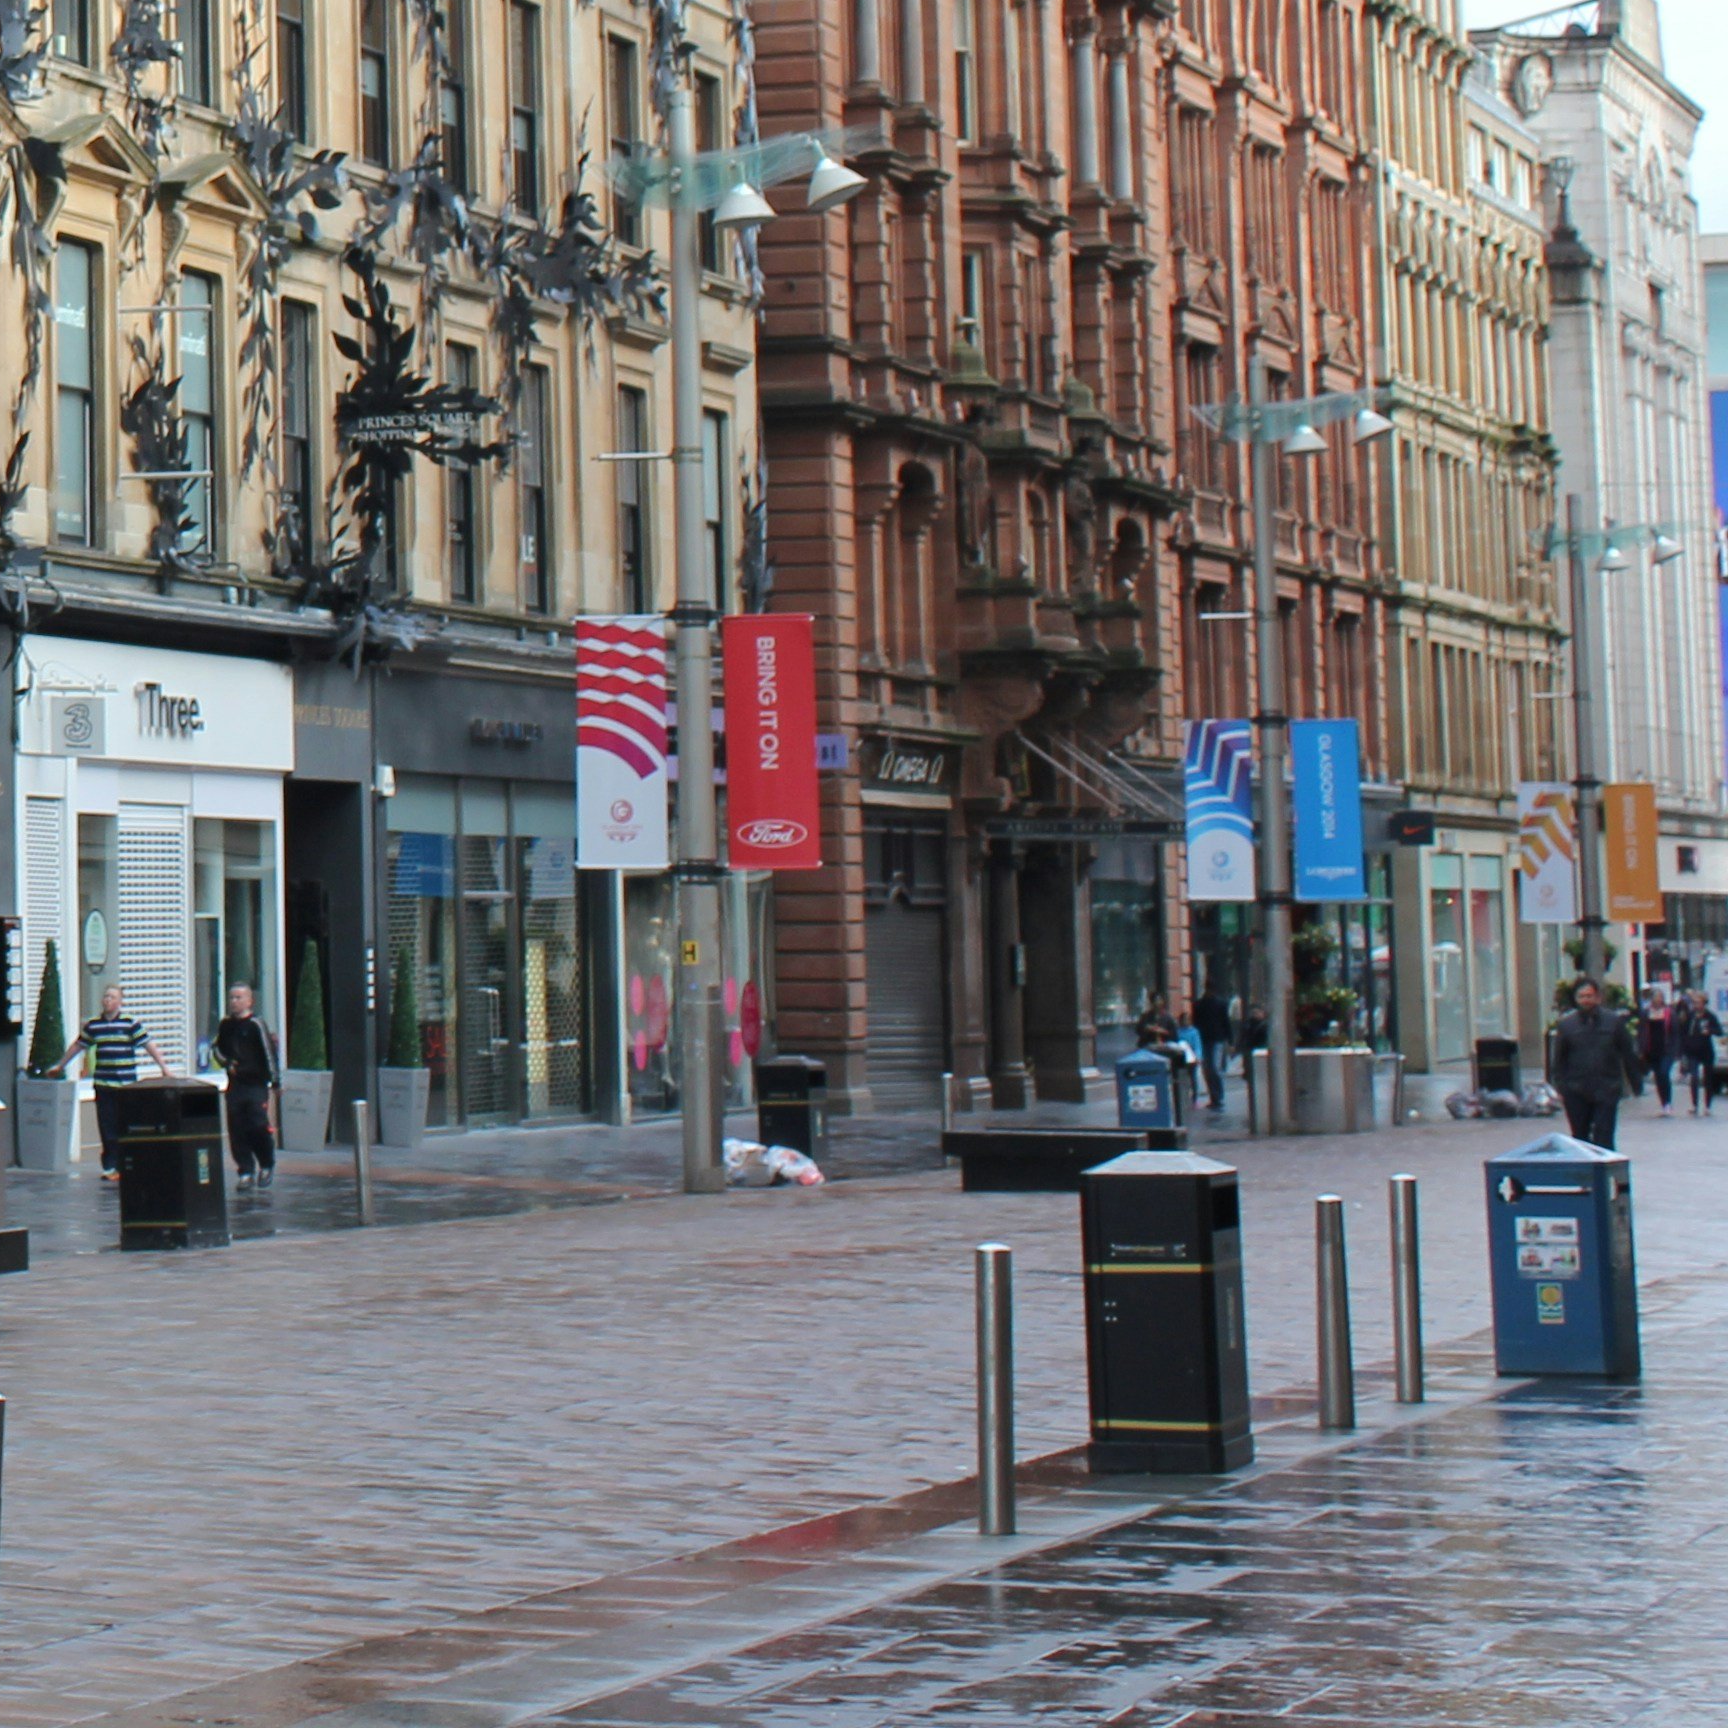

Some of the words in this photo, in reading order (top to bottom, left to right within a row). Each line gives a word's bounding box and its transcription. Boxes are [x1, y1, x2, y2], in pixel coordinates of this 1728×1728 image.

[357, 413, 417, 430] PRINCES
[756, 635, 778, 706] BRING
[63, 702, 93, 744] 3
[759, 710, 779, 731] IT
[759, 735, 780, 771] ON
[748, 823, 795, 844] Ford
